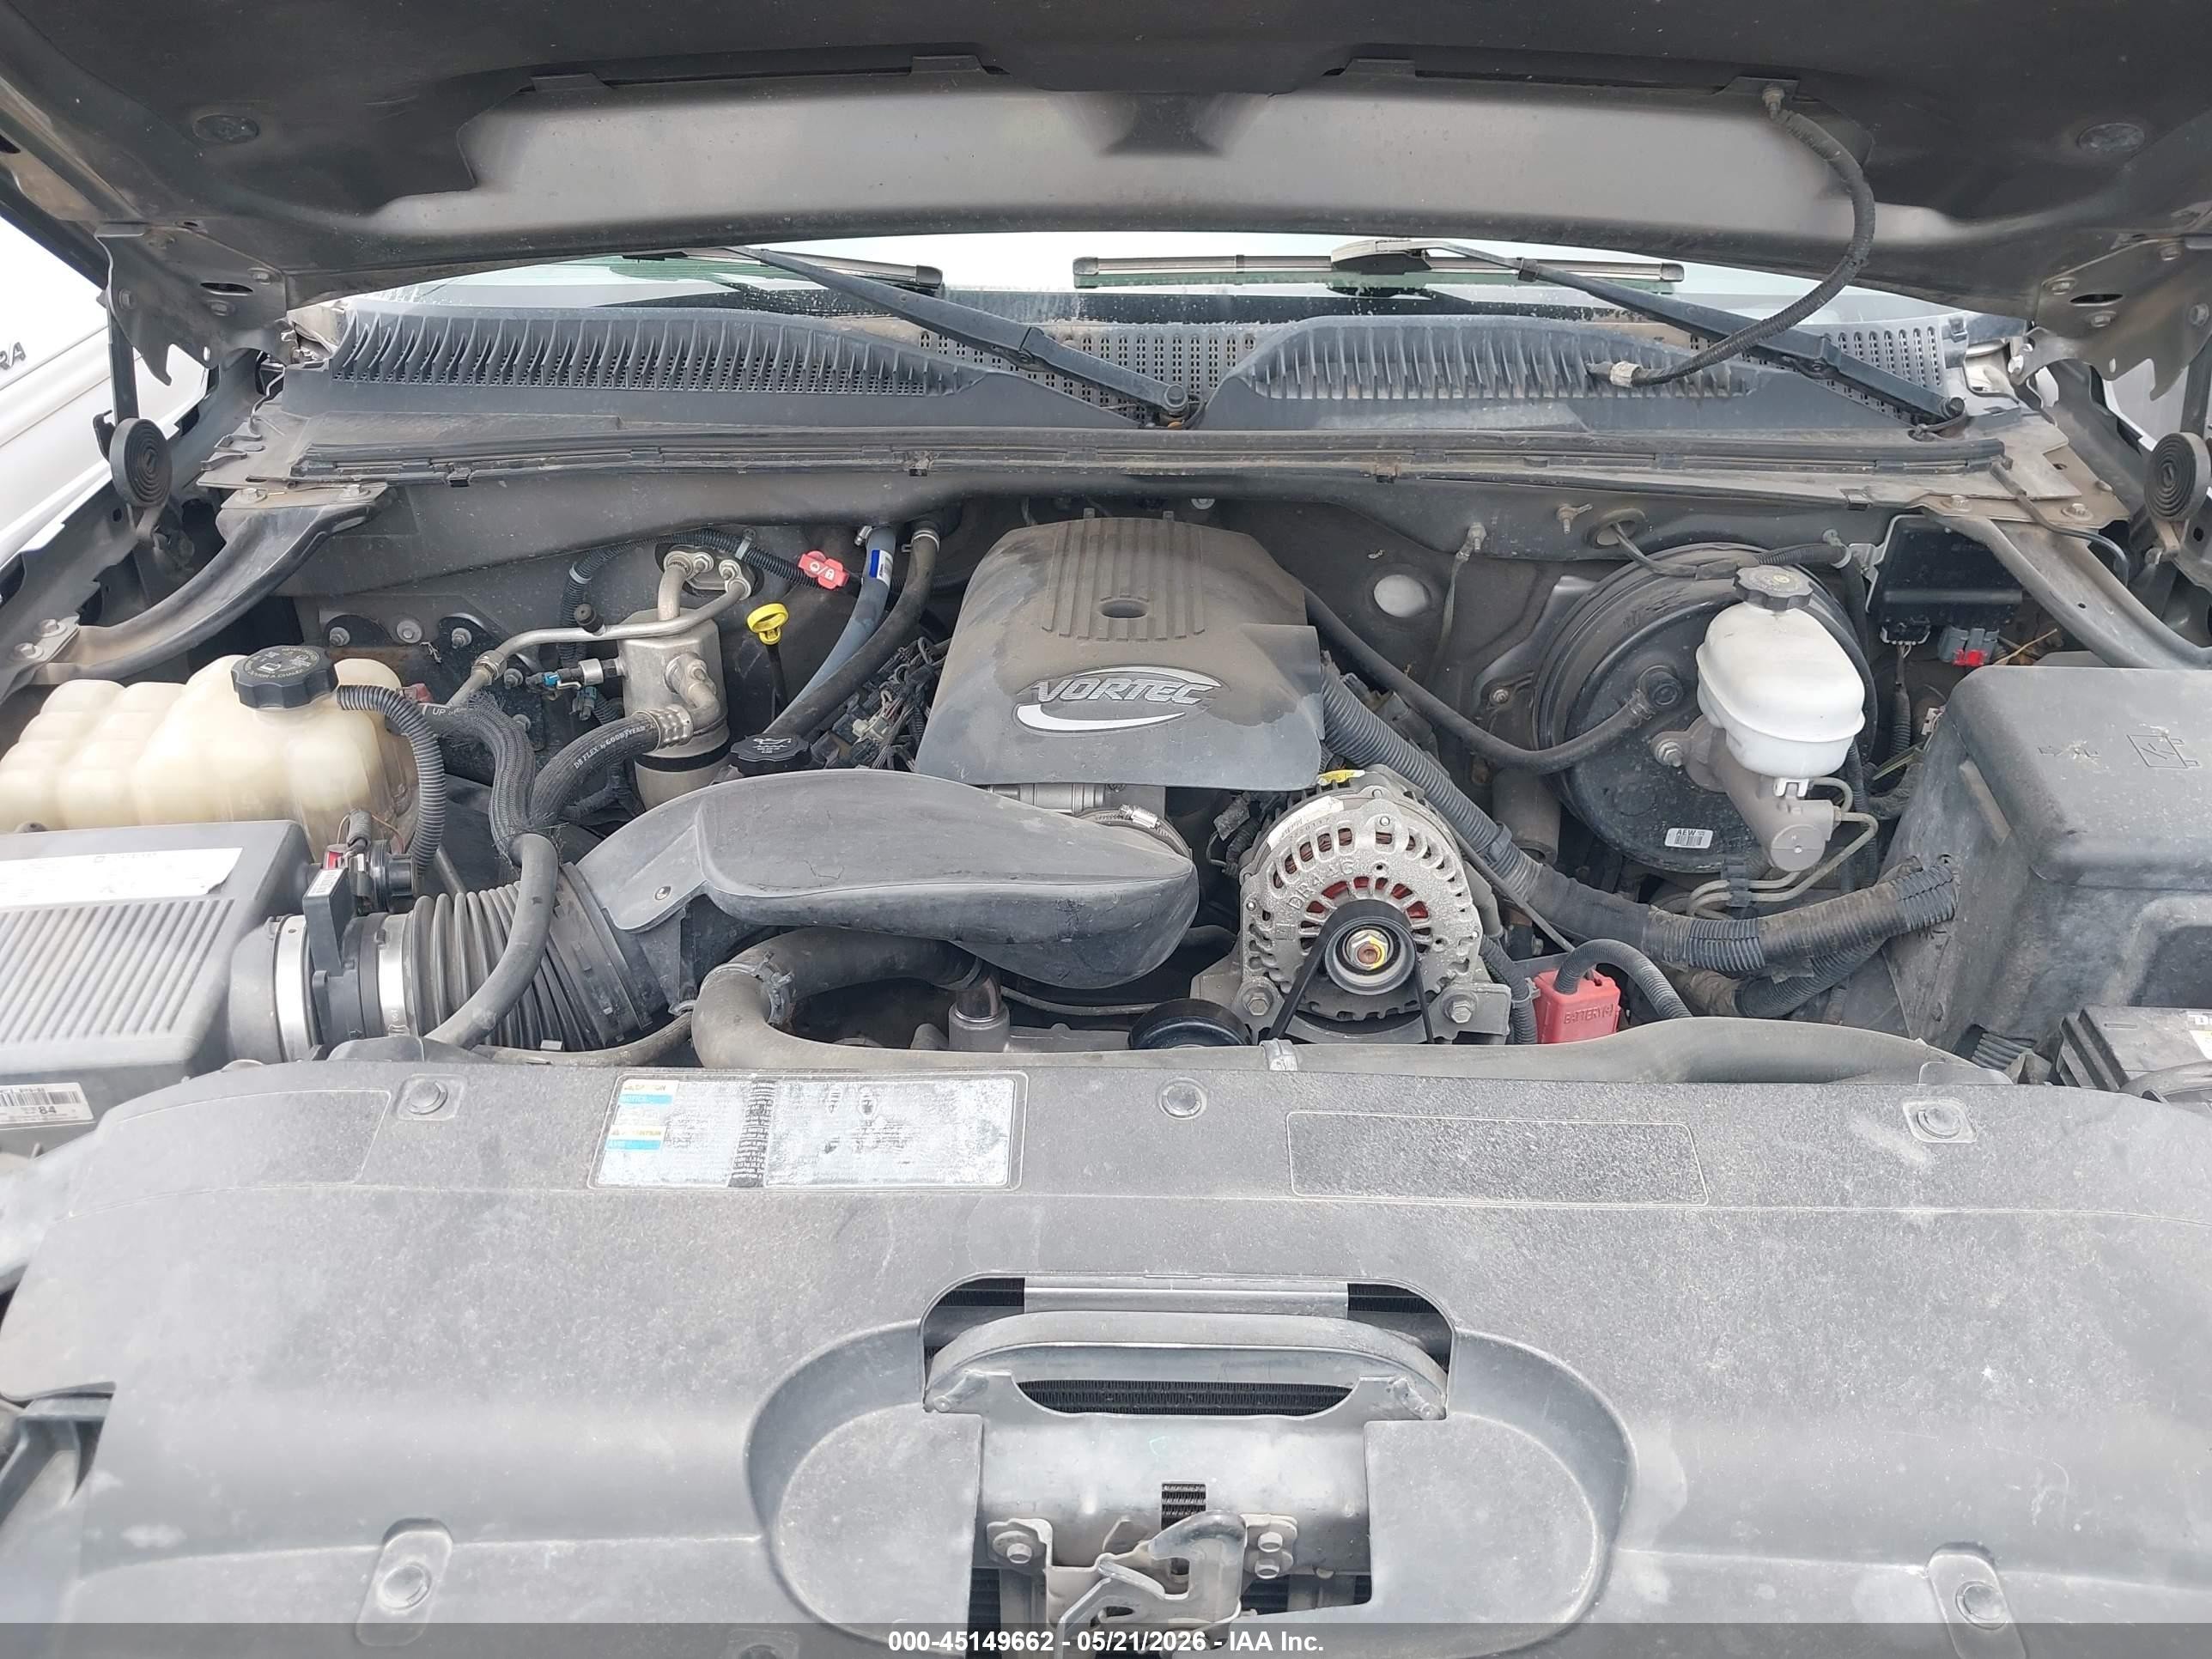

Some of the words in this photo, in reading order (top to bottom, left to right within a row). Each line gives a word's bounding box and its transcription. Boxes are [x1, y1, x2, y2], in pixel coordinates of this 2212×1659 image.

[1030, 678, 1214, 705] VORTEC
[432, 707, 446, 716] UP
[574, 759, 584, 769] DB
[583, 745, 599, 762] FLEX
[605, 725, 646, 745] GOODYEAR
